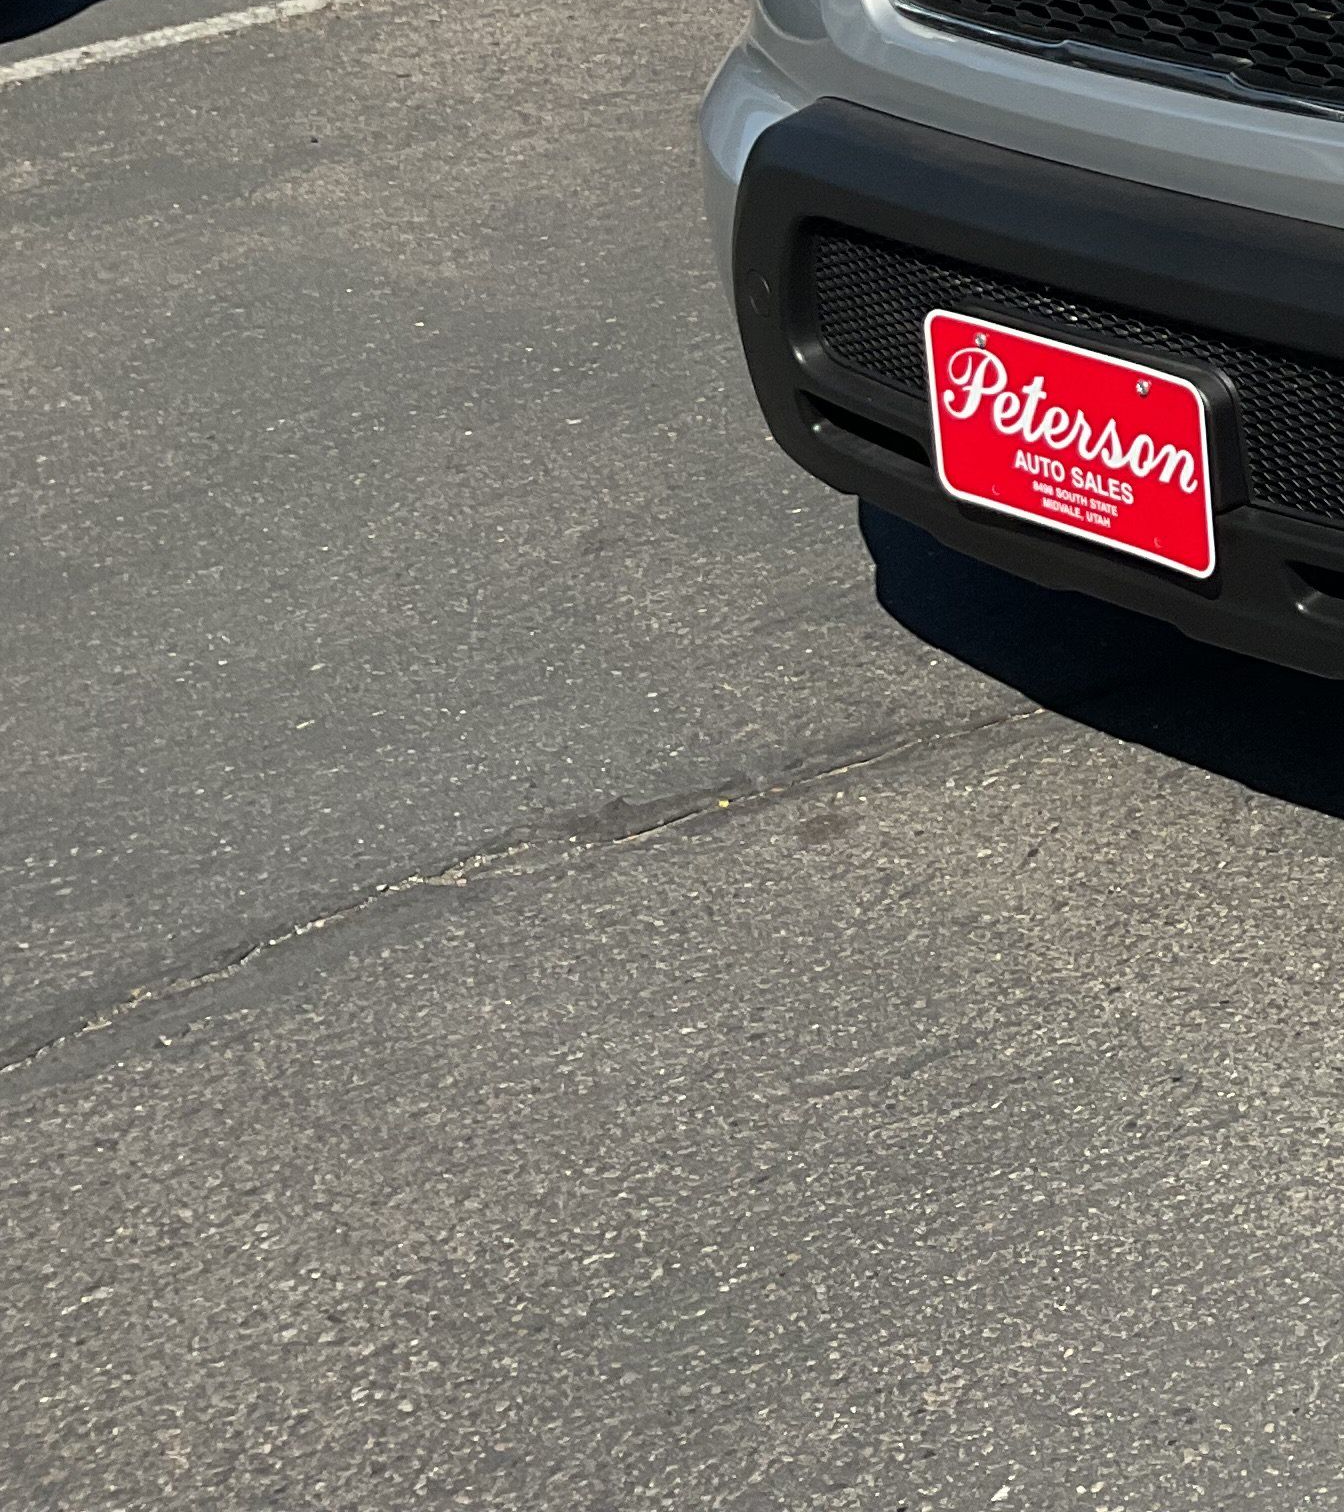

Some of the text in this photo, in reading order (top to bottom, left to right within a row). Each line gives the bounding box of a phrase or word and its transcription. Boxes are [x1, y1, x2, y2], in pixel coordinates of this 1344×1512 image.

[942, 346, 1198, 494] Peterson
[1014, 448, 1135, 505] AUTO SALES
[1055, 486, 1089, 507] SOUTH
[1089, 498, 1119, 517] STATE
[1085, 510, 1112, 528] UTAH
